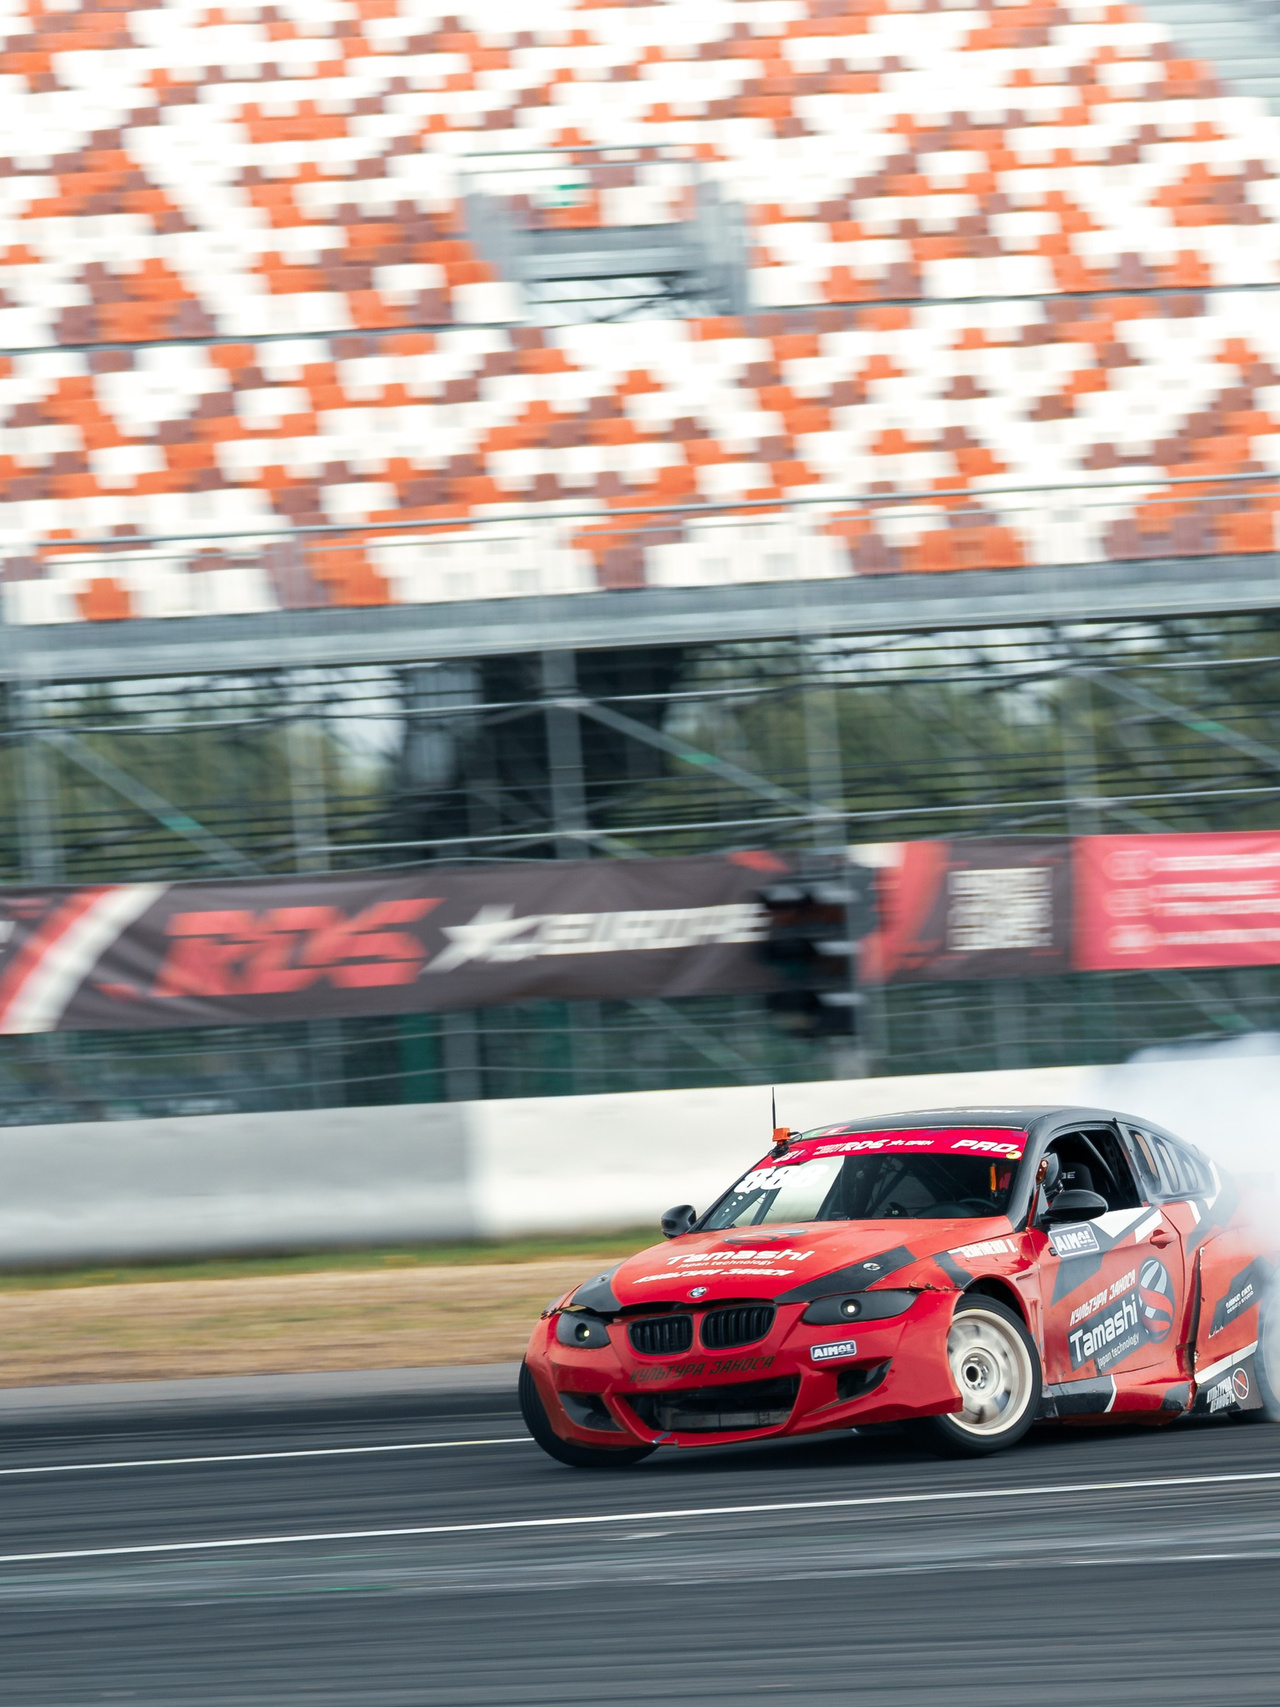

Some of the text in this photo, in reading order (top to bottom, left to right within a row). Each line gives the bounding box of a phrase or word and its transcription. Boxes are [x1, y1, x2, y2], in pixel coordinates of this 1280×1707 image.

[950, 1139, 1019, 1153] PRO
[667, 1249, 815, 1266] Tamashi
[1069, 1293, 1139, 1363] Tamashi
[1111, 1332, 1139, 1358] technology
[629, 1355, 776, 1384] КУЛЬТУРА ЗАНОСА
